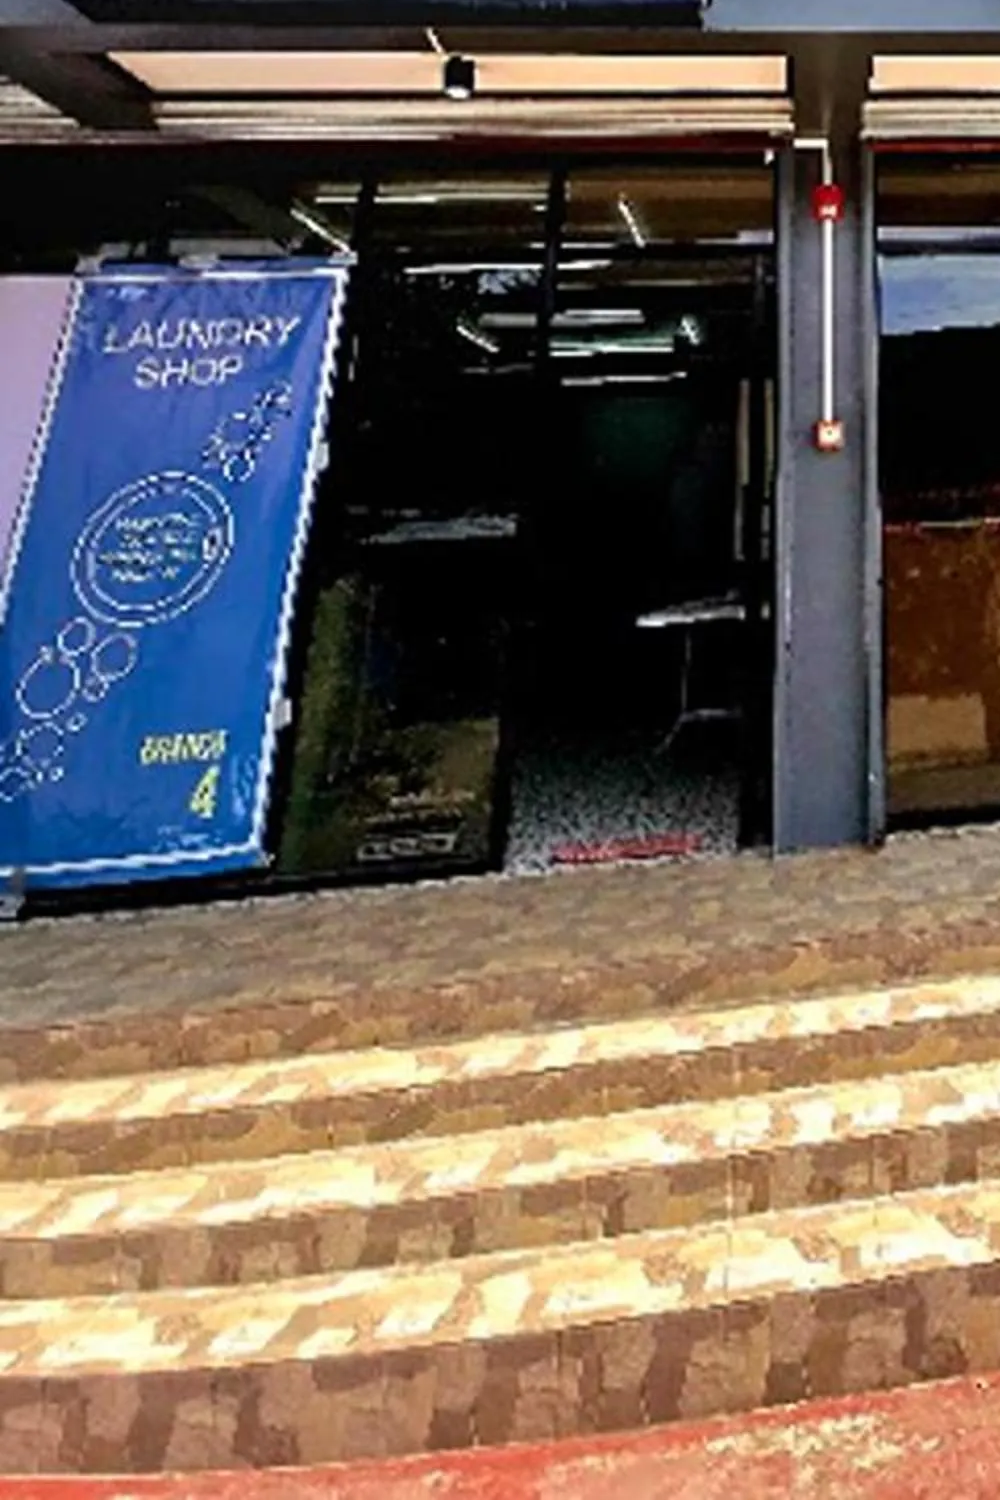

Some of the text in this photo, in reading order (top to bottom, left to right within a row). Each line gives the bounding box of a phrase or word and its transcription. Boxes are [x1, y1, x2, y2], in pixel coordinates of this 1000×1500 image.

[103, 314, 302, 353] LAUNDRY
[133, 354, 244, 390] SHOP
[189, 765, 221, 819] 4
